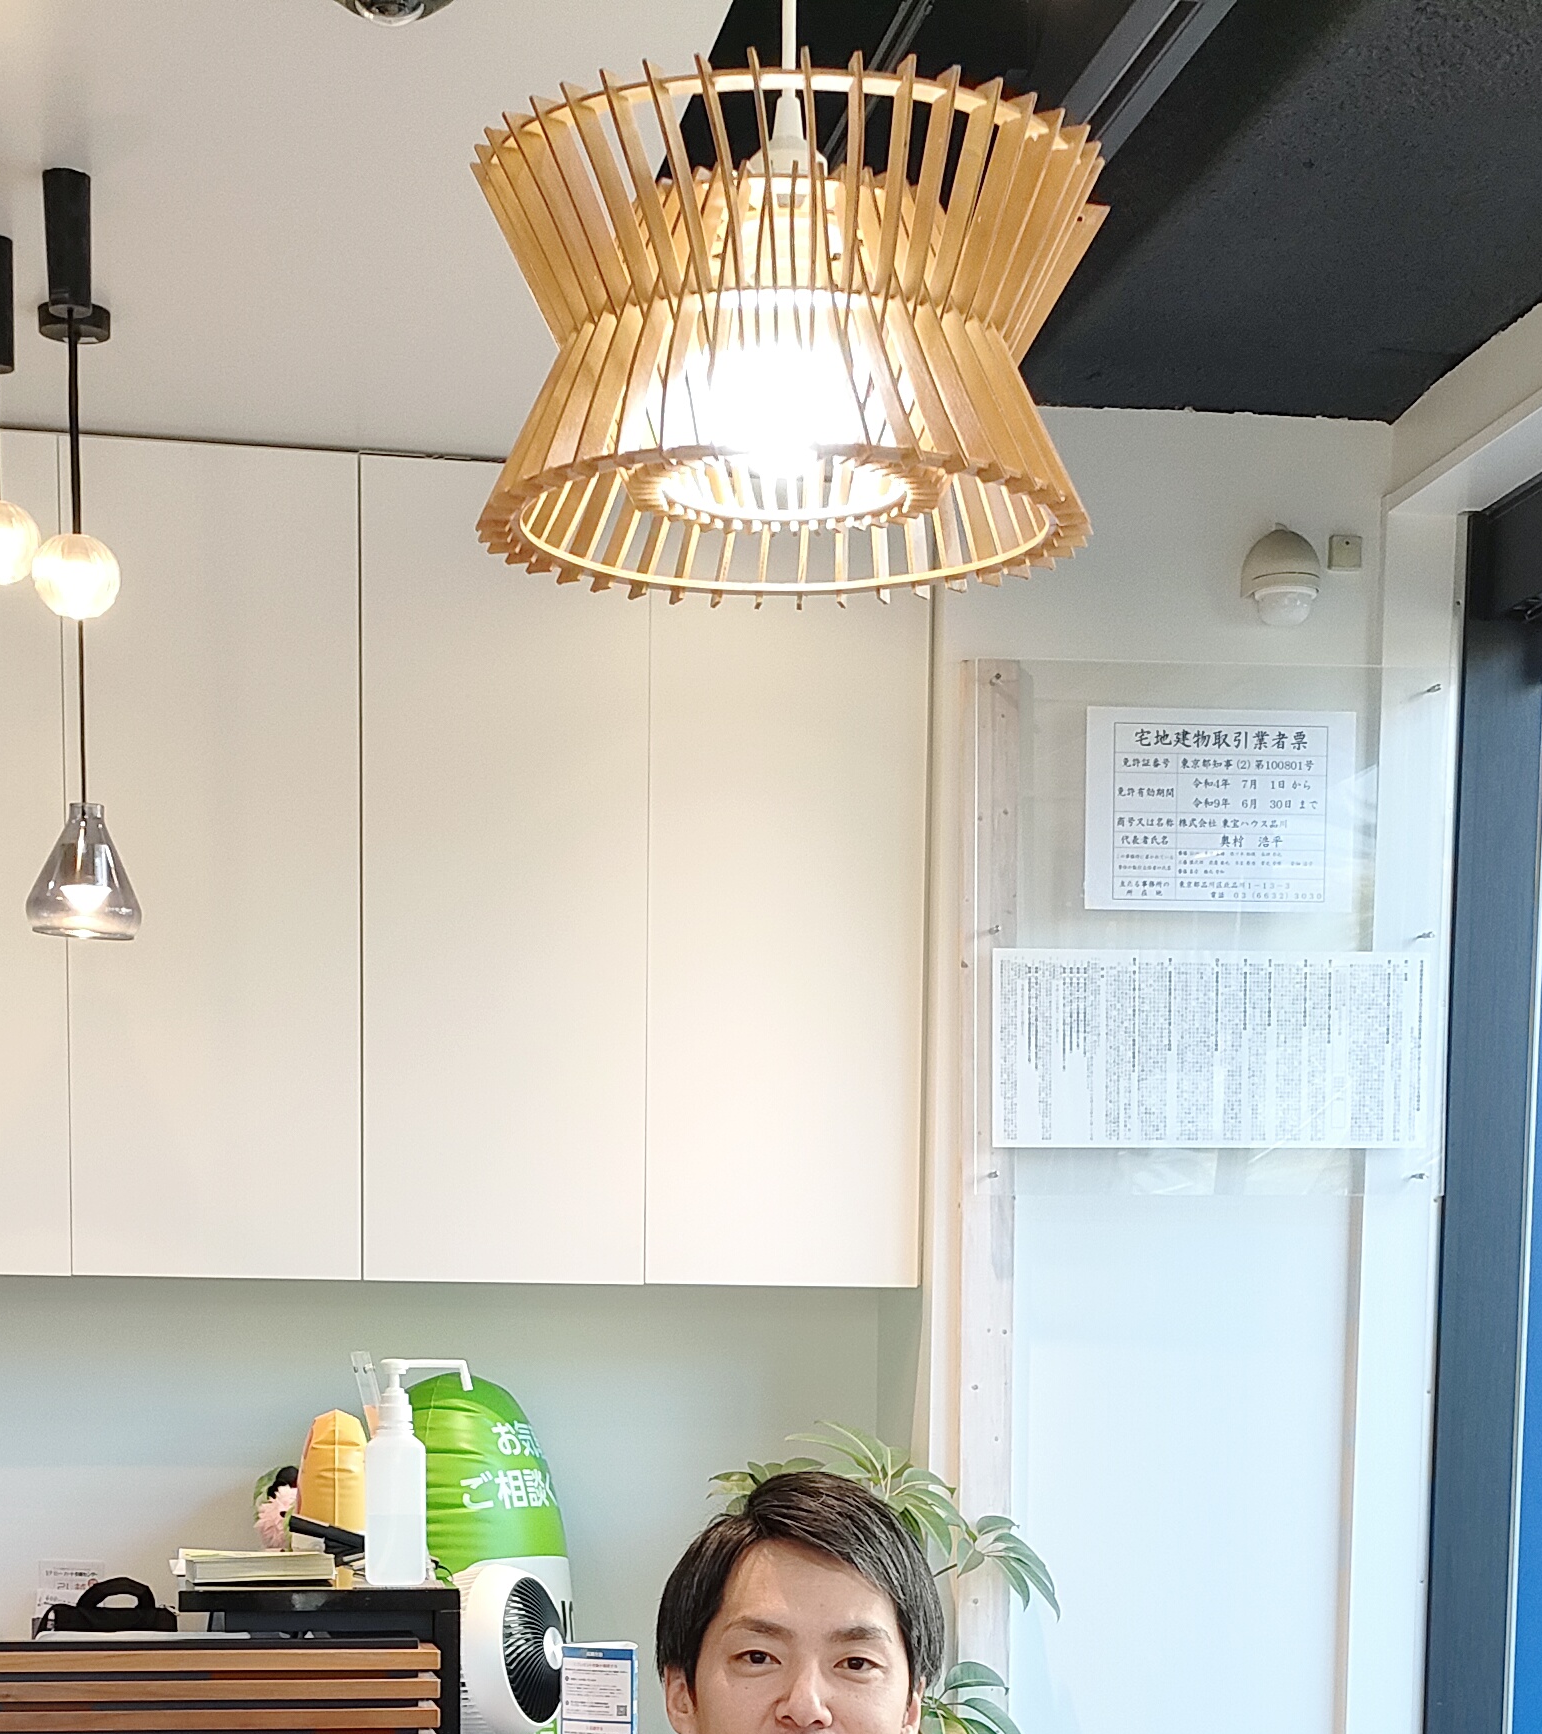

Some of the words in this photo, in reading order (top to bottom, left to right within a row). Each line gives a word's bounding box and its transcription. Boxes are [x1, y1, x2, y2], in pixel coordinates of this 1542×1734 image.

[1134, 728, 1308, 750] 宅地建物取引業者票
[1121, 757, 1170, 768] 免許証番号
[1180, 758, 1233, 770] 東京都知事
[1117, 787, 1175, 798] 免許有効期間
[1116, 817, 1175, 828] 商号又は名称
[1178, 817, 1217, 828] 株式会社
[1221, 818, 1288, 829] 東宝ハウス品川
[1120, 834, 1169, 846] 代表者氏名
[491, 1420, 546, 1461] お気
